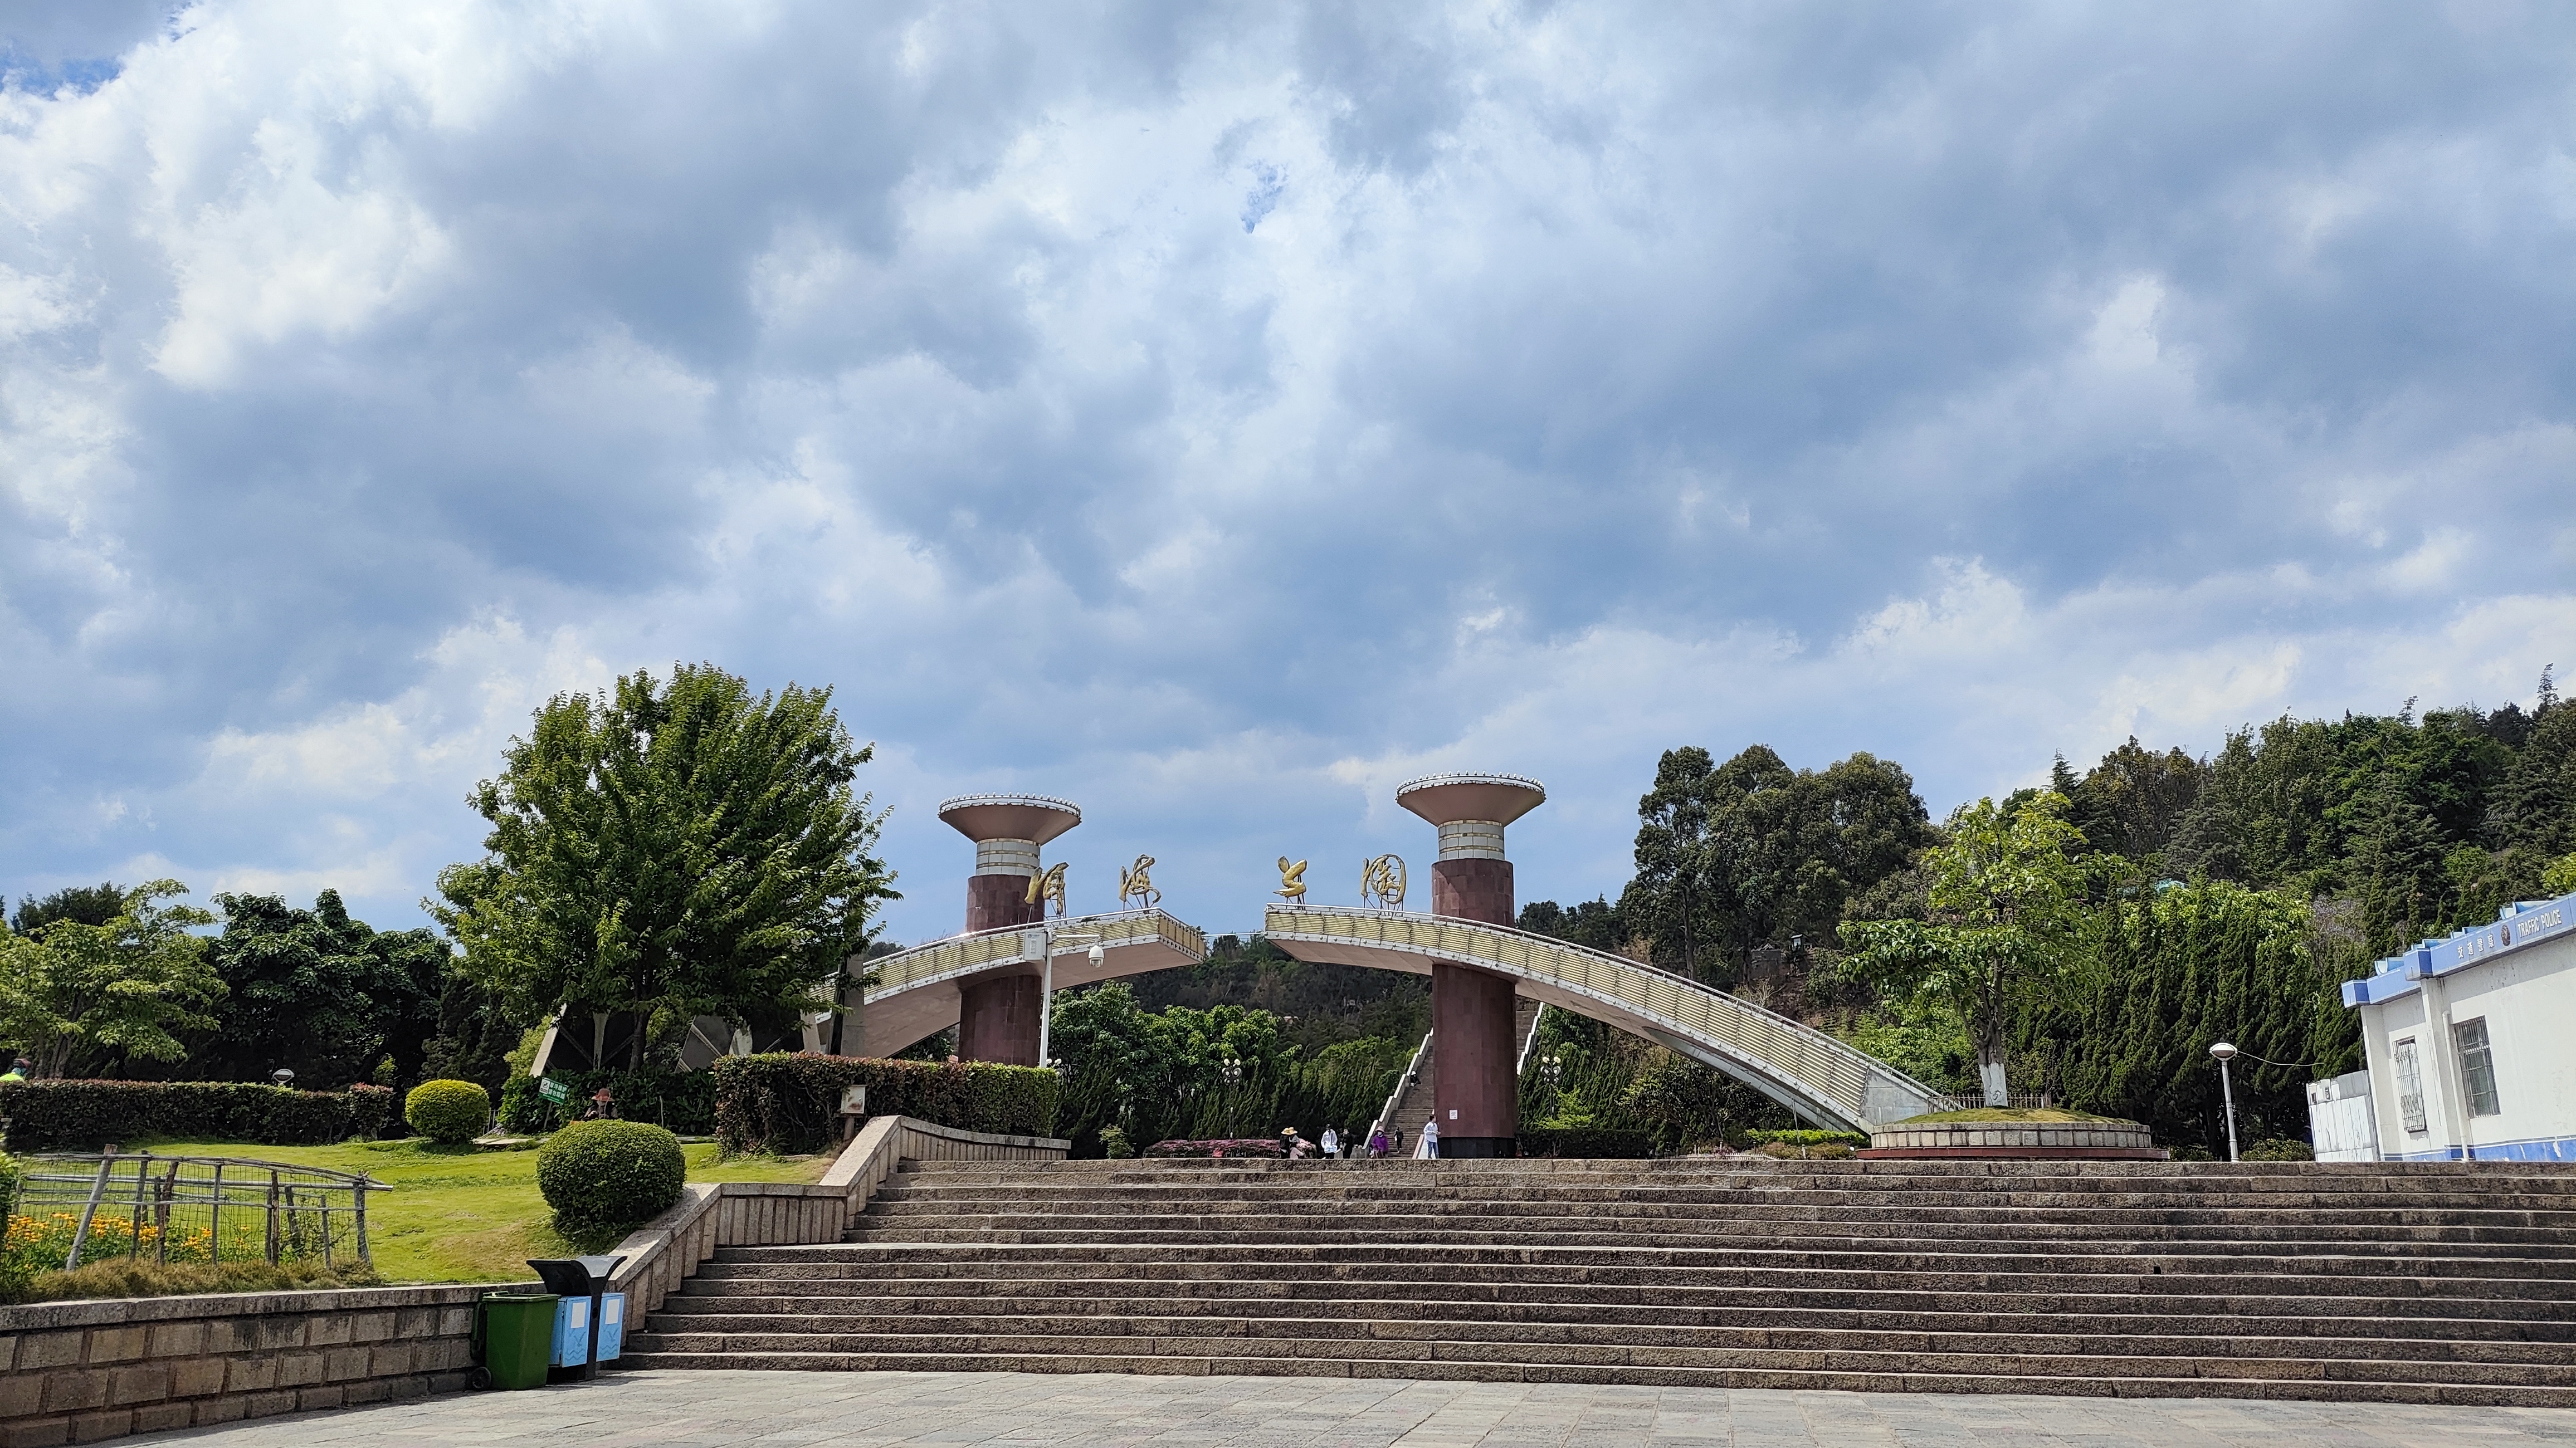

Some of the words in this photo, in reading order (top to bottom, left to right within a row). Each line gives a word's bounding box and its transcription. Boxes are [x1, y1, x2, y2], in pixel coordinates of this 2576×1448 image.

[2517, 917, 2540, 938] TRAFFIC
[2540, 909, 2563, 930] POLICE
[2457, 933, 2494, 959] 交通警察
